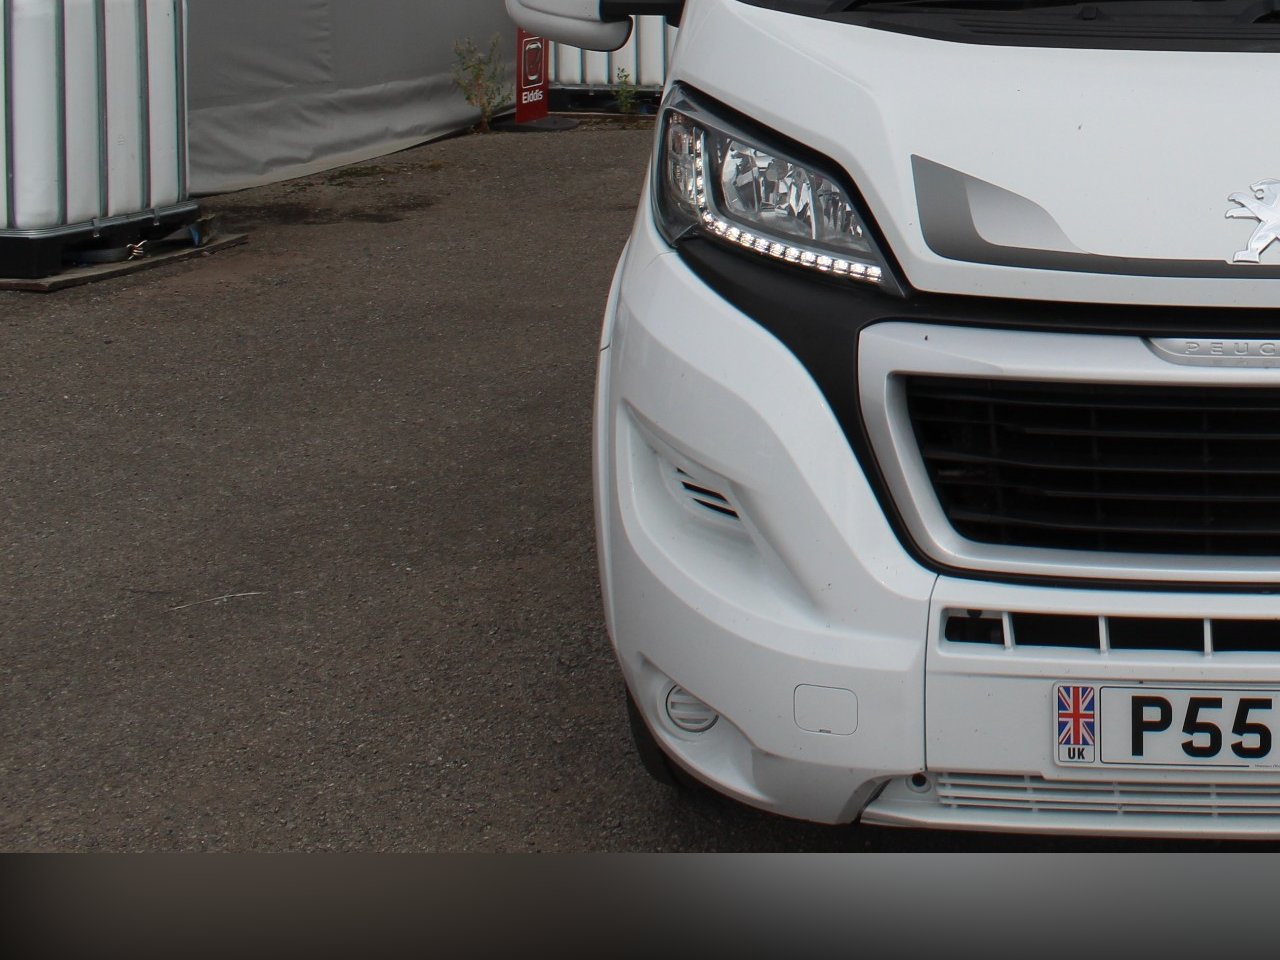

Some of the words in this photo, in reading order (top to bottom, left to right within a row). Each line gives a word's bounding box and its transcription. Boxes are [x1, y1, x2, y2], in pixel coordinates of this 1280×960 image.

[522, 89, 544, 104] Elddis
[1131, 695, 1272, 759] P55
[1067, 747, 1086, 760] UK
